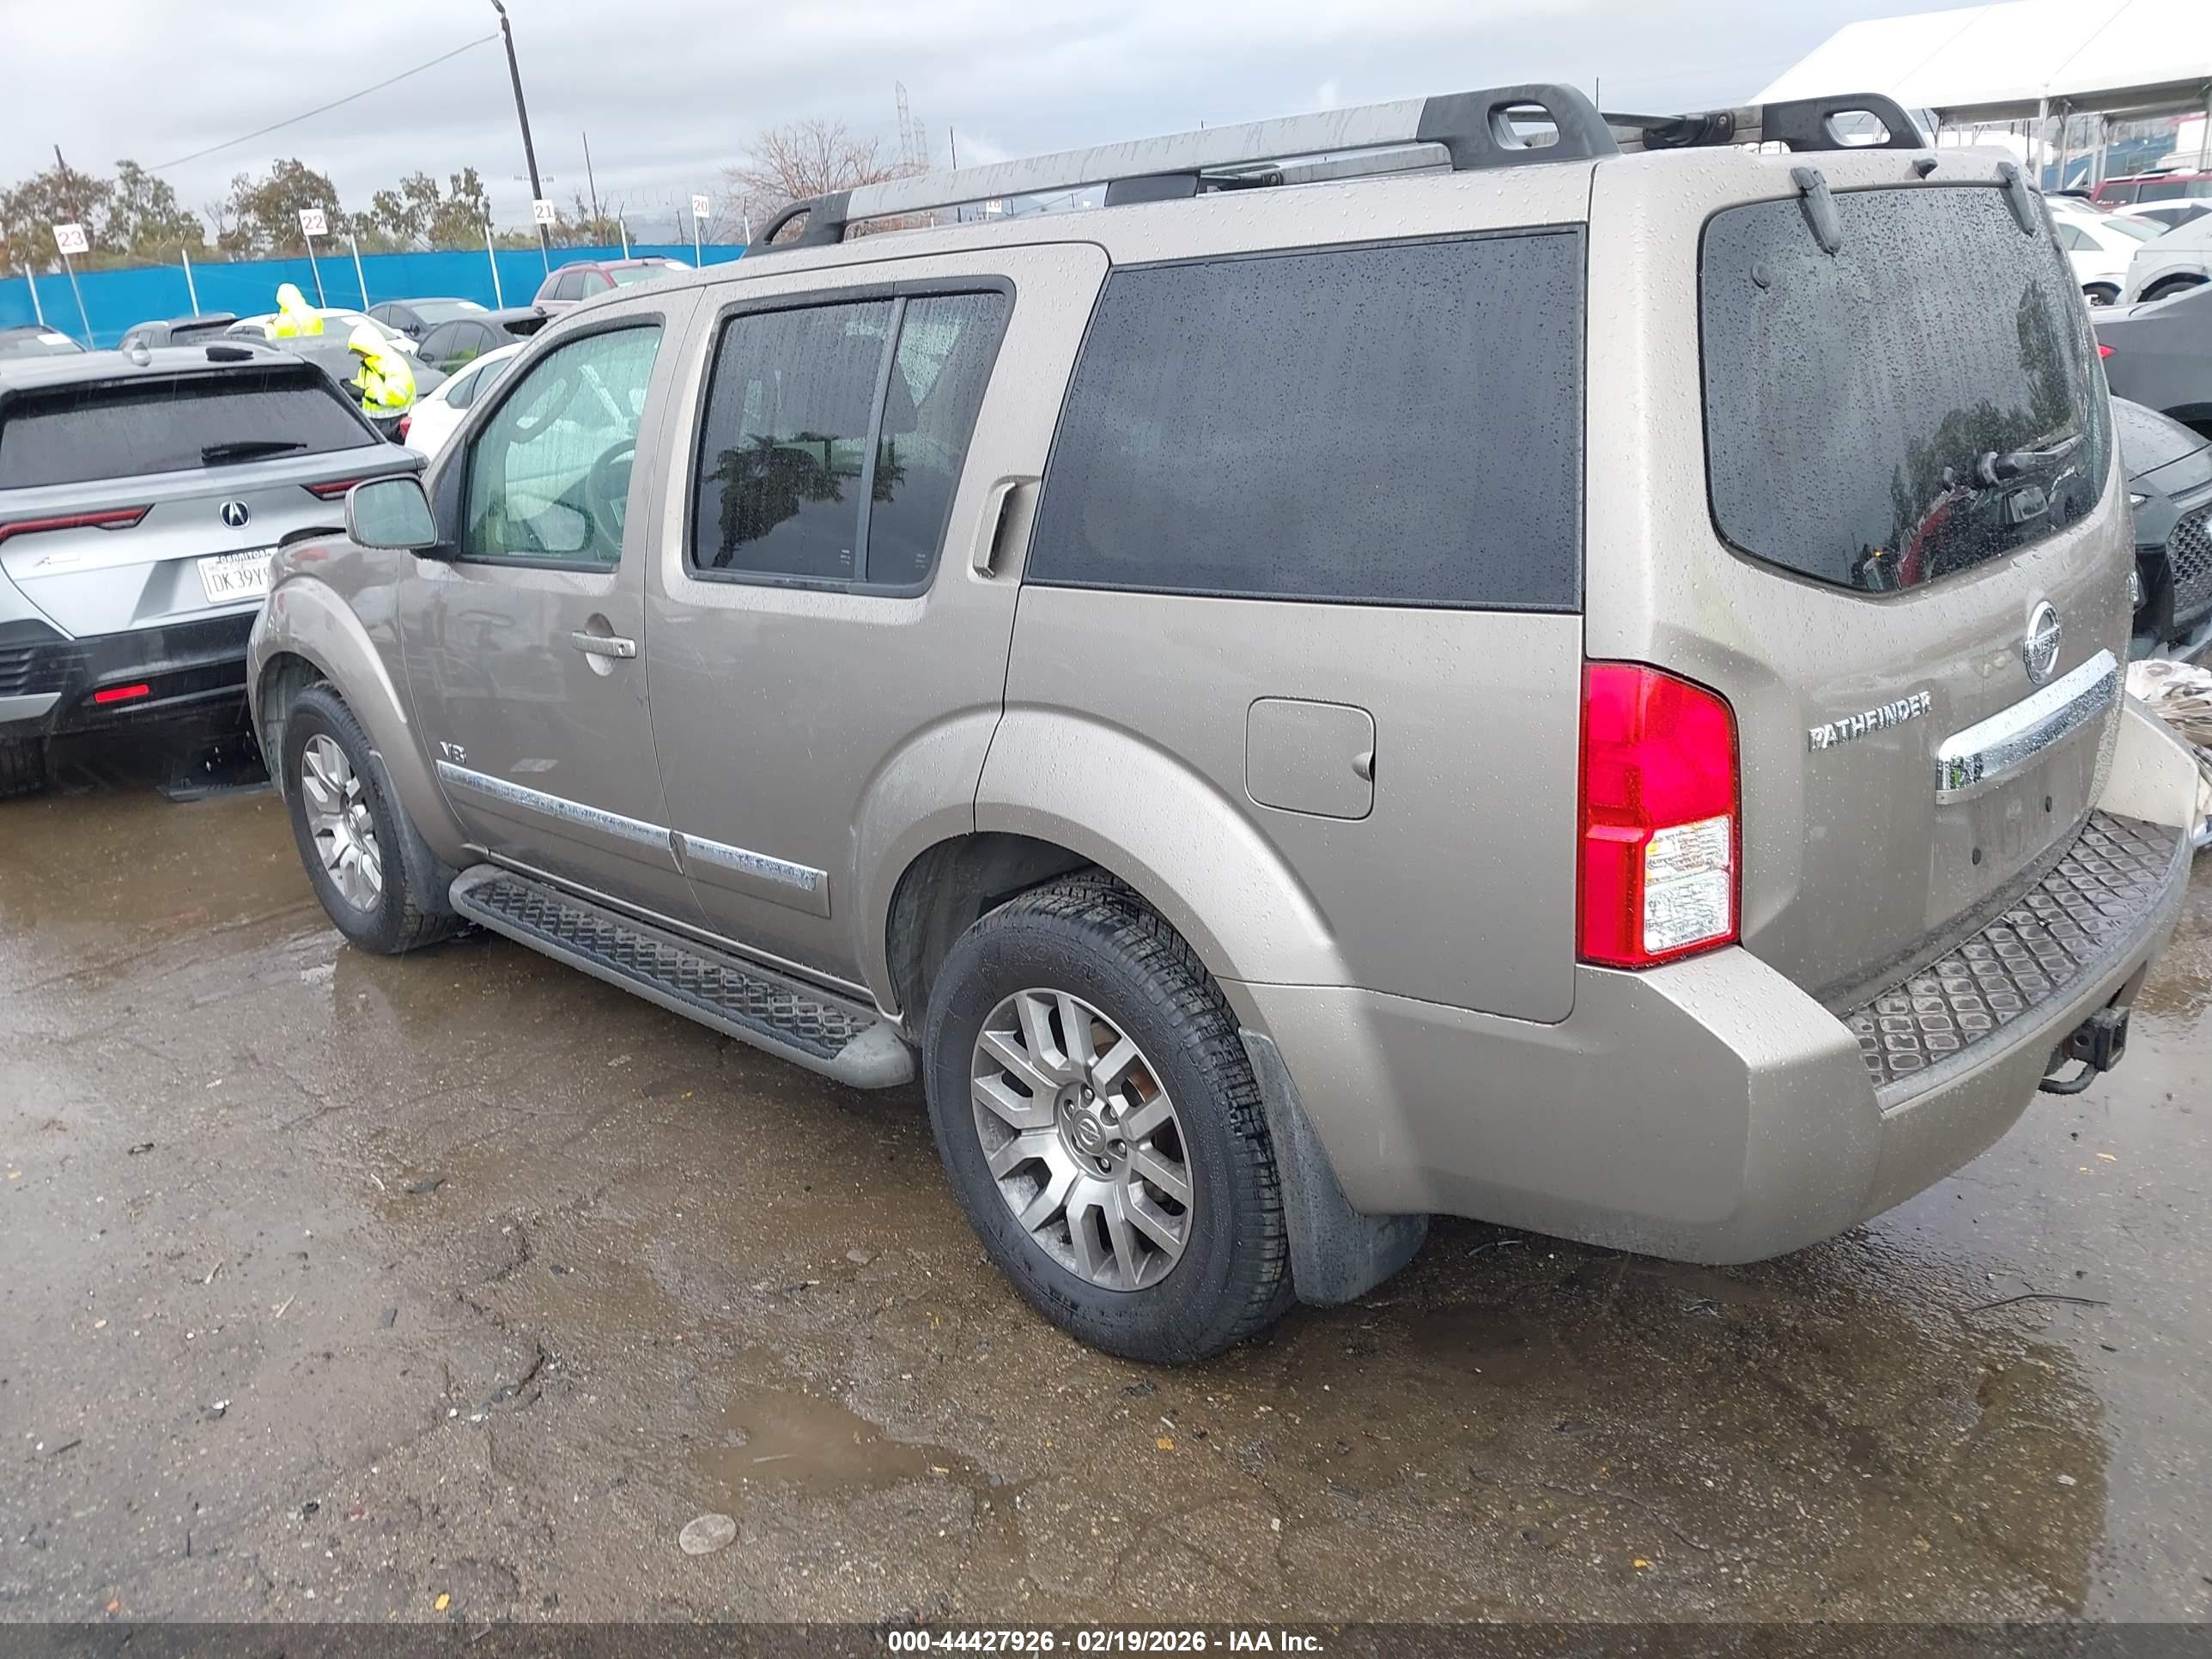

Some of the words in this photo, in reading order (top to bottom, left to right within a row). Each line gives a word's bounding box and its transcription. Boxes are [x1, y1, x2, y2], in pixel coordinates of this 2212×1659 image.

[535, 205, 554, 218] 21
[694, 199, 708, 213] 20
[302, 215, 325, 229] 22
[58, 230, 84, 247] 23
[1808, 690, 1933, 750] PATHFINDER
